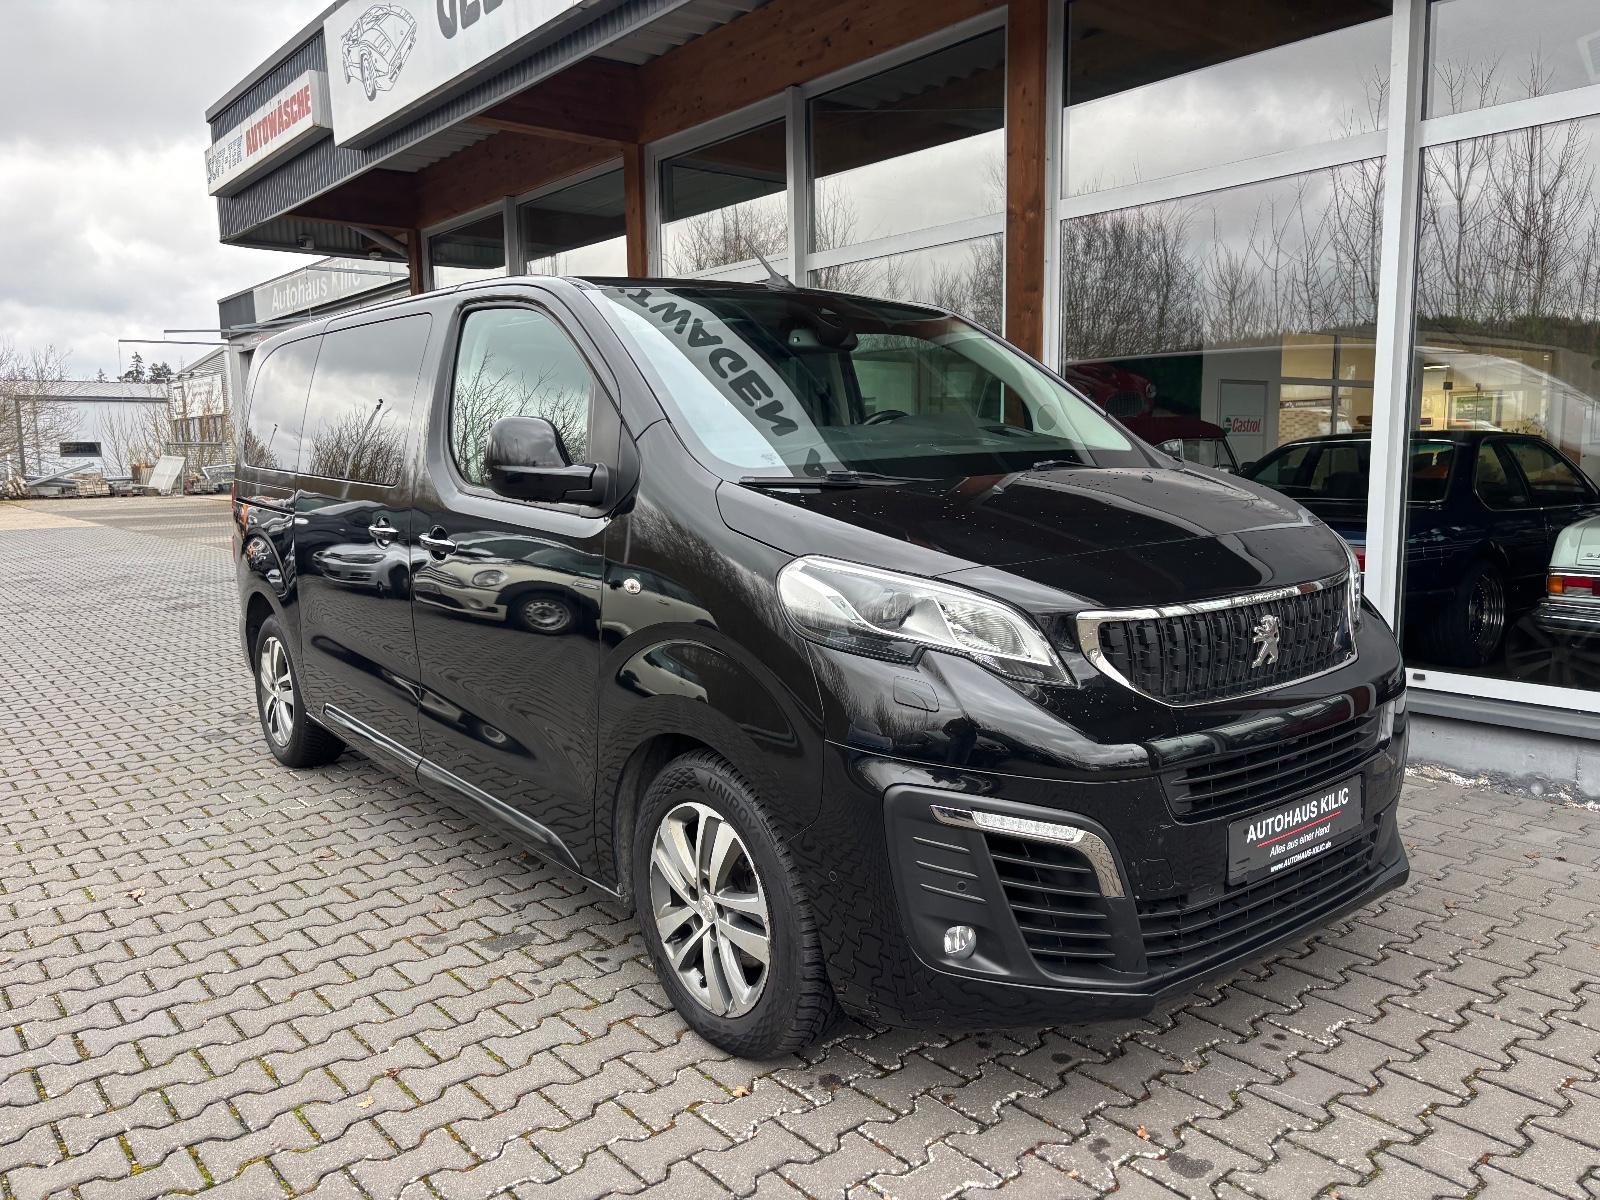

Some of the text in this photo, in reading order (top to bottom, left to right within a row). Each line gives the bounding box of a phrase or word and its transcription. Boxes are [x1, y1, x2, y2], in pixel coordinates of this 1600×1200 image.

[245, 84, 311, 157] AUTOWÄSCHE
[272, 275, 328, 312] Autohaus
[1232, 417, 1261, 432] Castrol
[707, 777, 763, 842] UNIROYA
[1246, 787, 1349, 844] AUTOHAUS KILIC
[1270, 822, 1331, 858] Alles aus einer Hand
